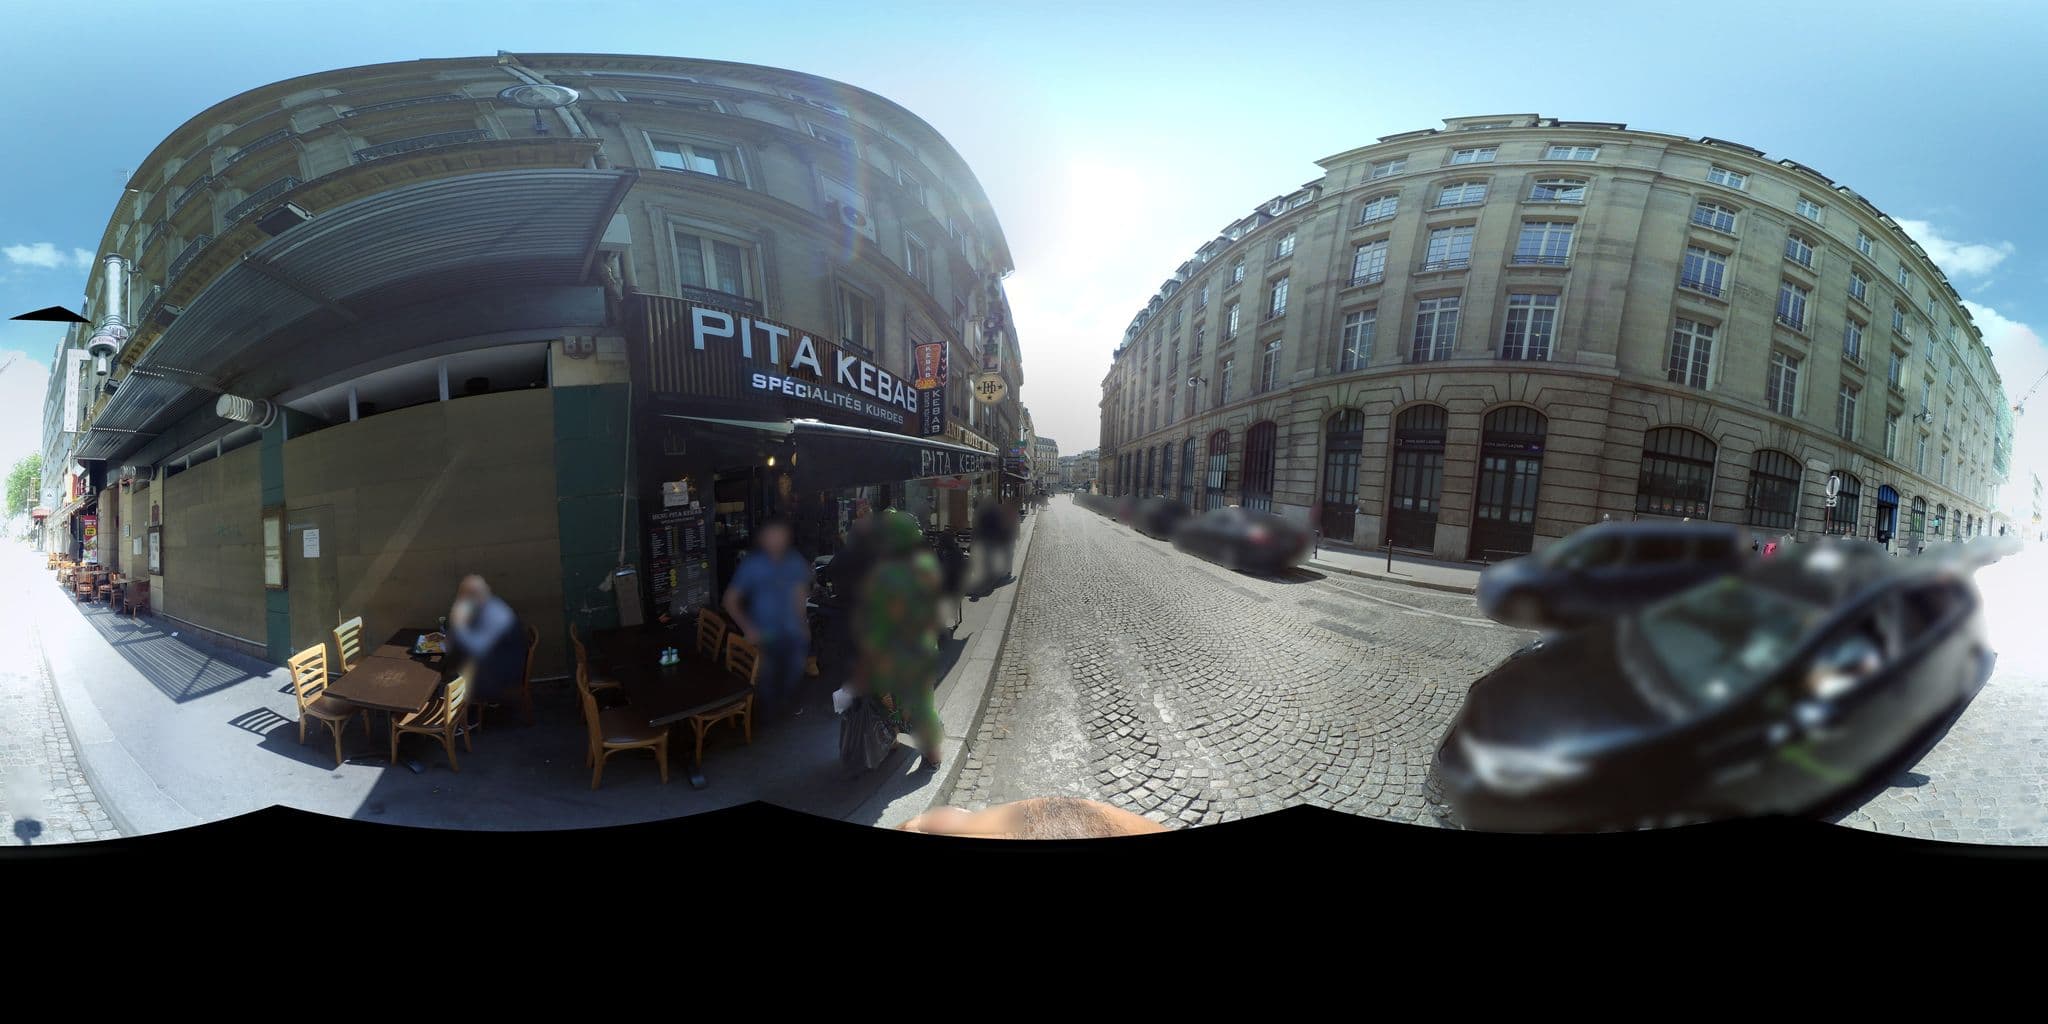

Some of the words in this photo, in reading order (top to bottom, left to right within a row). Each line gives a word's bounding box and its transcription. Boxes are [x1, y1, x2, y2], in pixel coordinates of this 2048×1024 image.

[691, 306, 823, 377] PITA
[837, 349, 918, 414] KEBAB
[752, 373, 862, 411] SPÉCIALITÉS
[866, 403, 904, 425] KURDES
[932, 389, 941, 433] KEBAB
[921, 449, 952, 477] PITA
